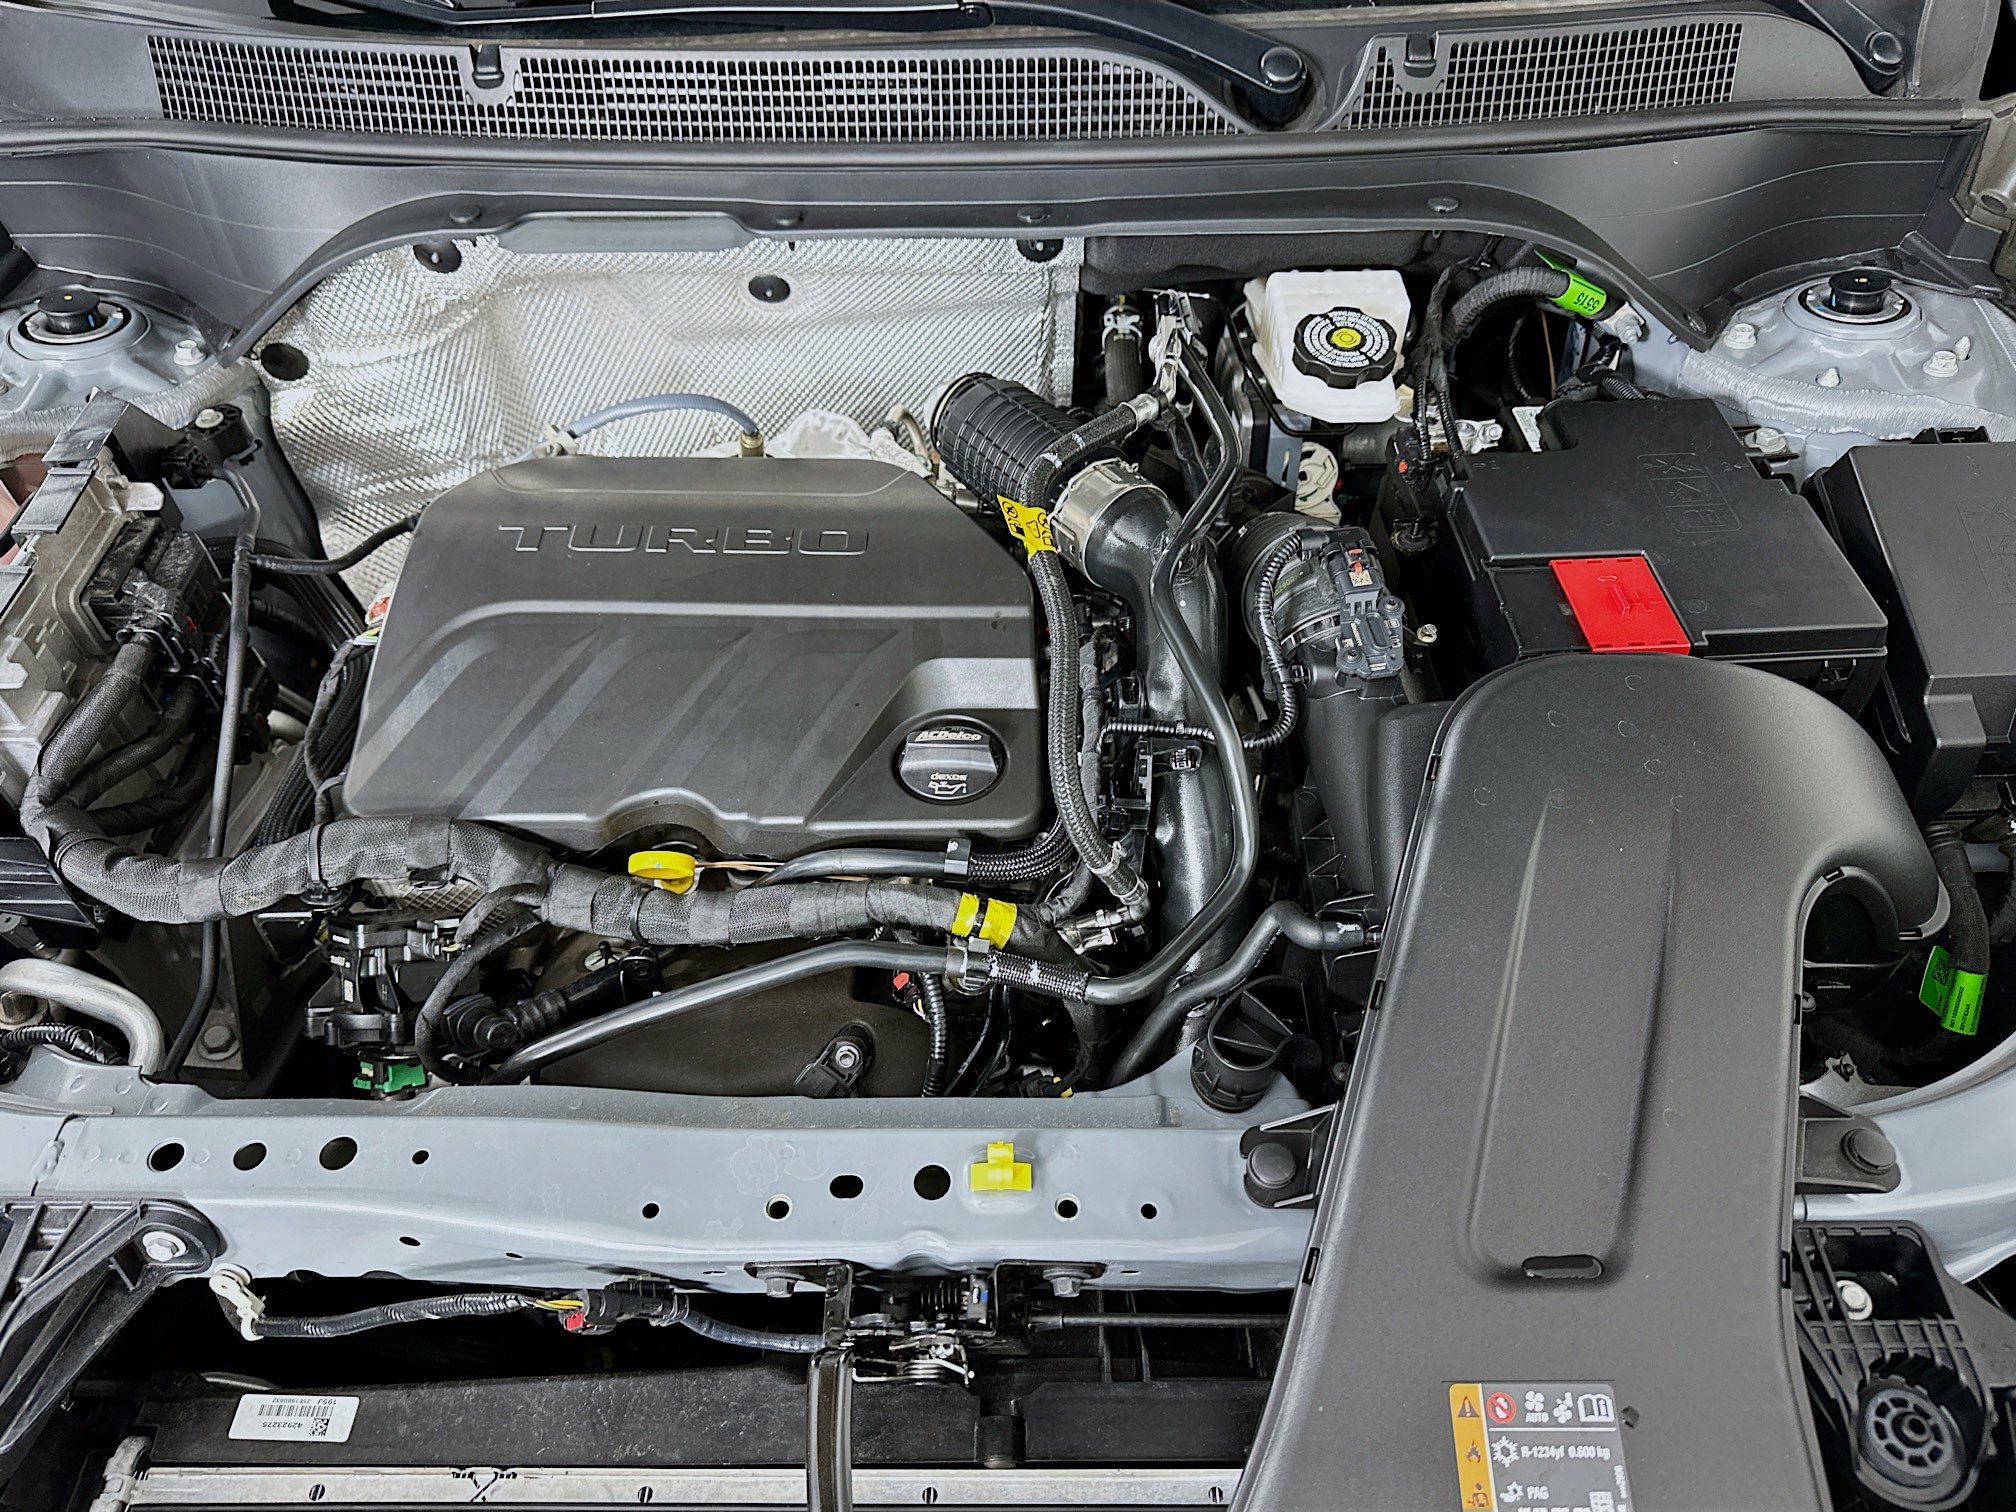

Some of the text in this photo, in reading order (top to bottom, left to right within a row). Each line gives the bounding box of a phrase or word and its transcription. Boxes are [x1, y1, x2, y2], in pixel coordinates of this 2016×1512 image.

[1573, 292, 1600, 311] 5515
[498, 524, 870, 556] TURBO
[914, 730, 982, 743] ACDelco
[930, 772, 969, 781] dexos
[1525, 1412, 1550, 1424] AUTO
[262, 1421, 304, 1429] 42923275
[1520, 1445, 1611, 1461] R-1234yf 0.600 kg
[1527, 1486, 1549, 1500] PAG
